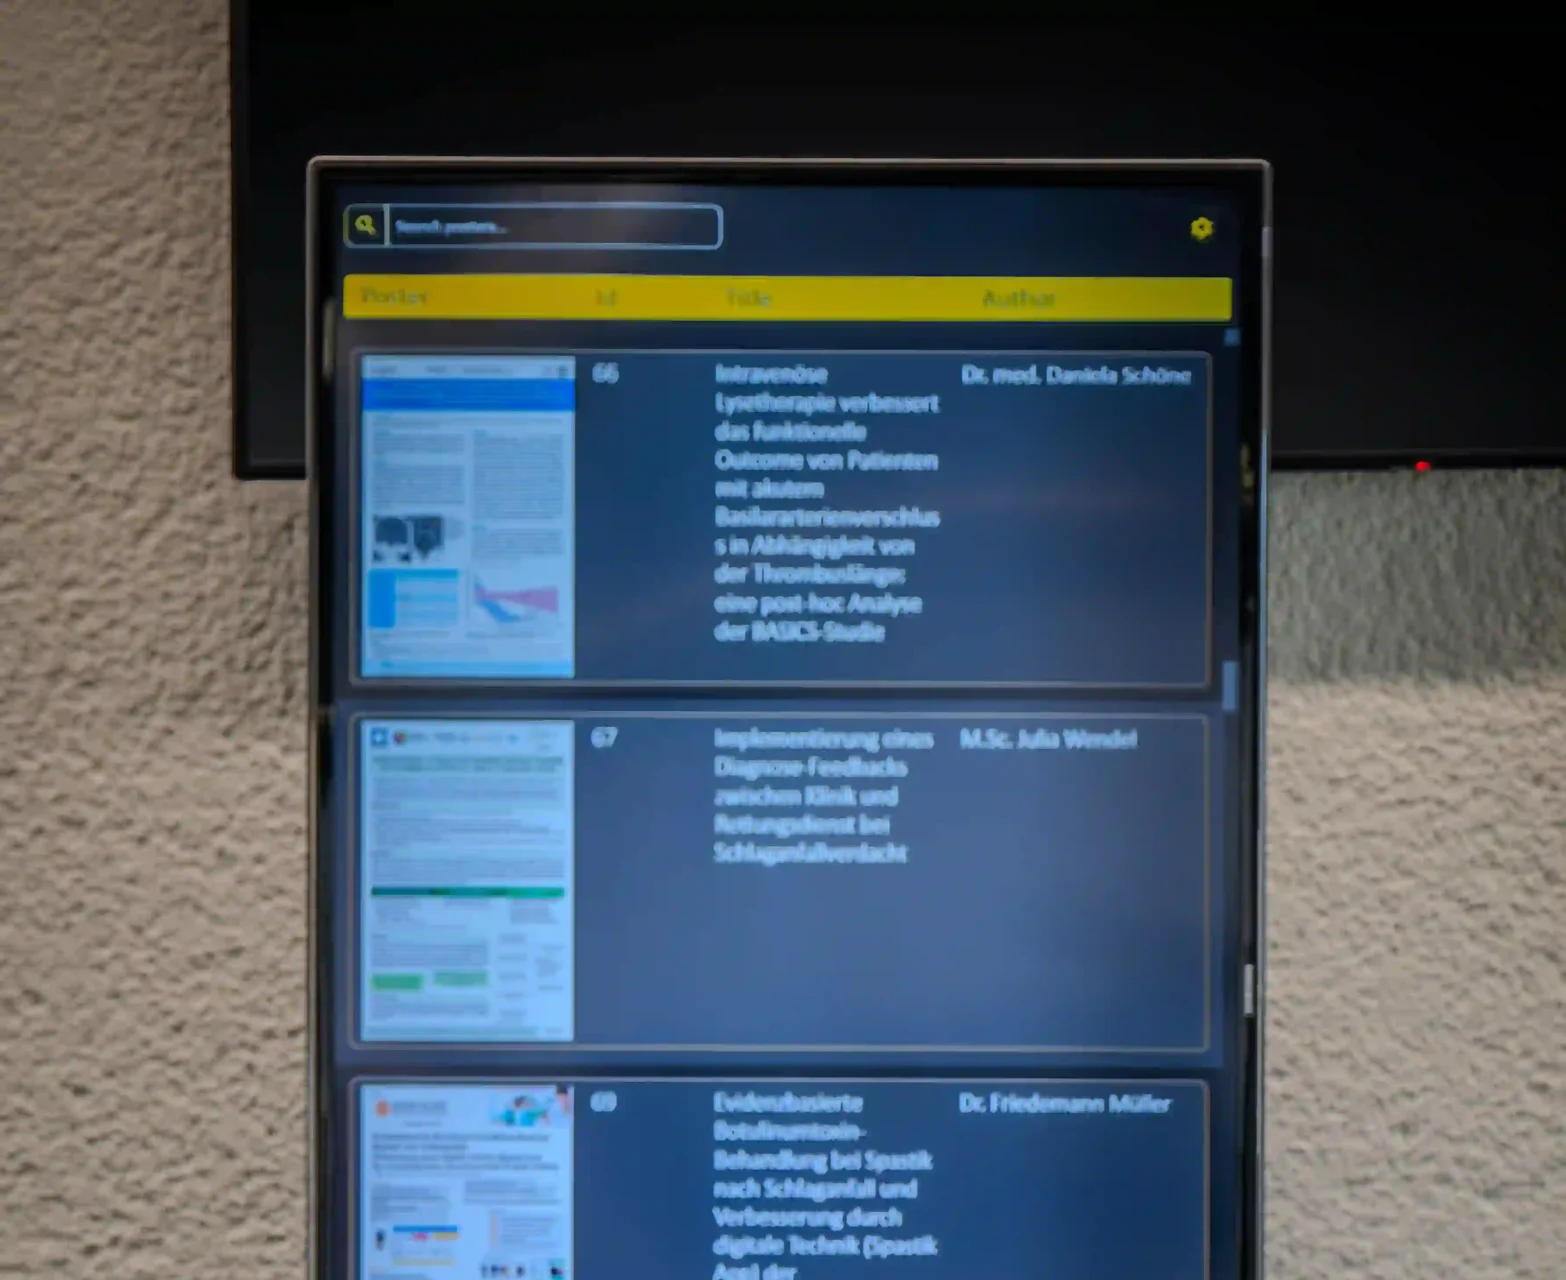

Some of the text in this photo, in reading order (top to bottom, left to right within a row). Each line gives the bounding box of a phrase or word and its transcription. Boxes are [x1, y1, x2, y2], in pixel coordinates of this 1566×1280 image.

[361, 287, 428, 305] Poster
[727, 289, 771, 307] Title
[983, 290, 1057, 308] Author
[962, 364, 988, 385] Dr.
[993, 365, 1041, 385] med.
[807, 452, 843, 470] von
[847, 449, 938, 470] Patienten
[878, 539, 915, 555] von
[714, 562, 749, 584] der
[714, 592, 757, 613] eine
[847, 592, 923, 617] Analyse
[714, 620, 749, 641] der
[860, 785, 898, 806] und
[859, 814, 890, 835] bei
[959, 1093, 986, 1114] Dr.
[714, 1149, 828, 1174] Behandlung
[831, 1149, 861, 1170] bei
[714, 1177, 918, 1202] nach Schlaganfall und
[847, 1206, 903, 1227] durch
